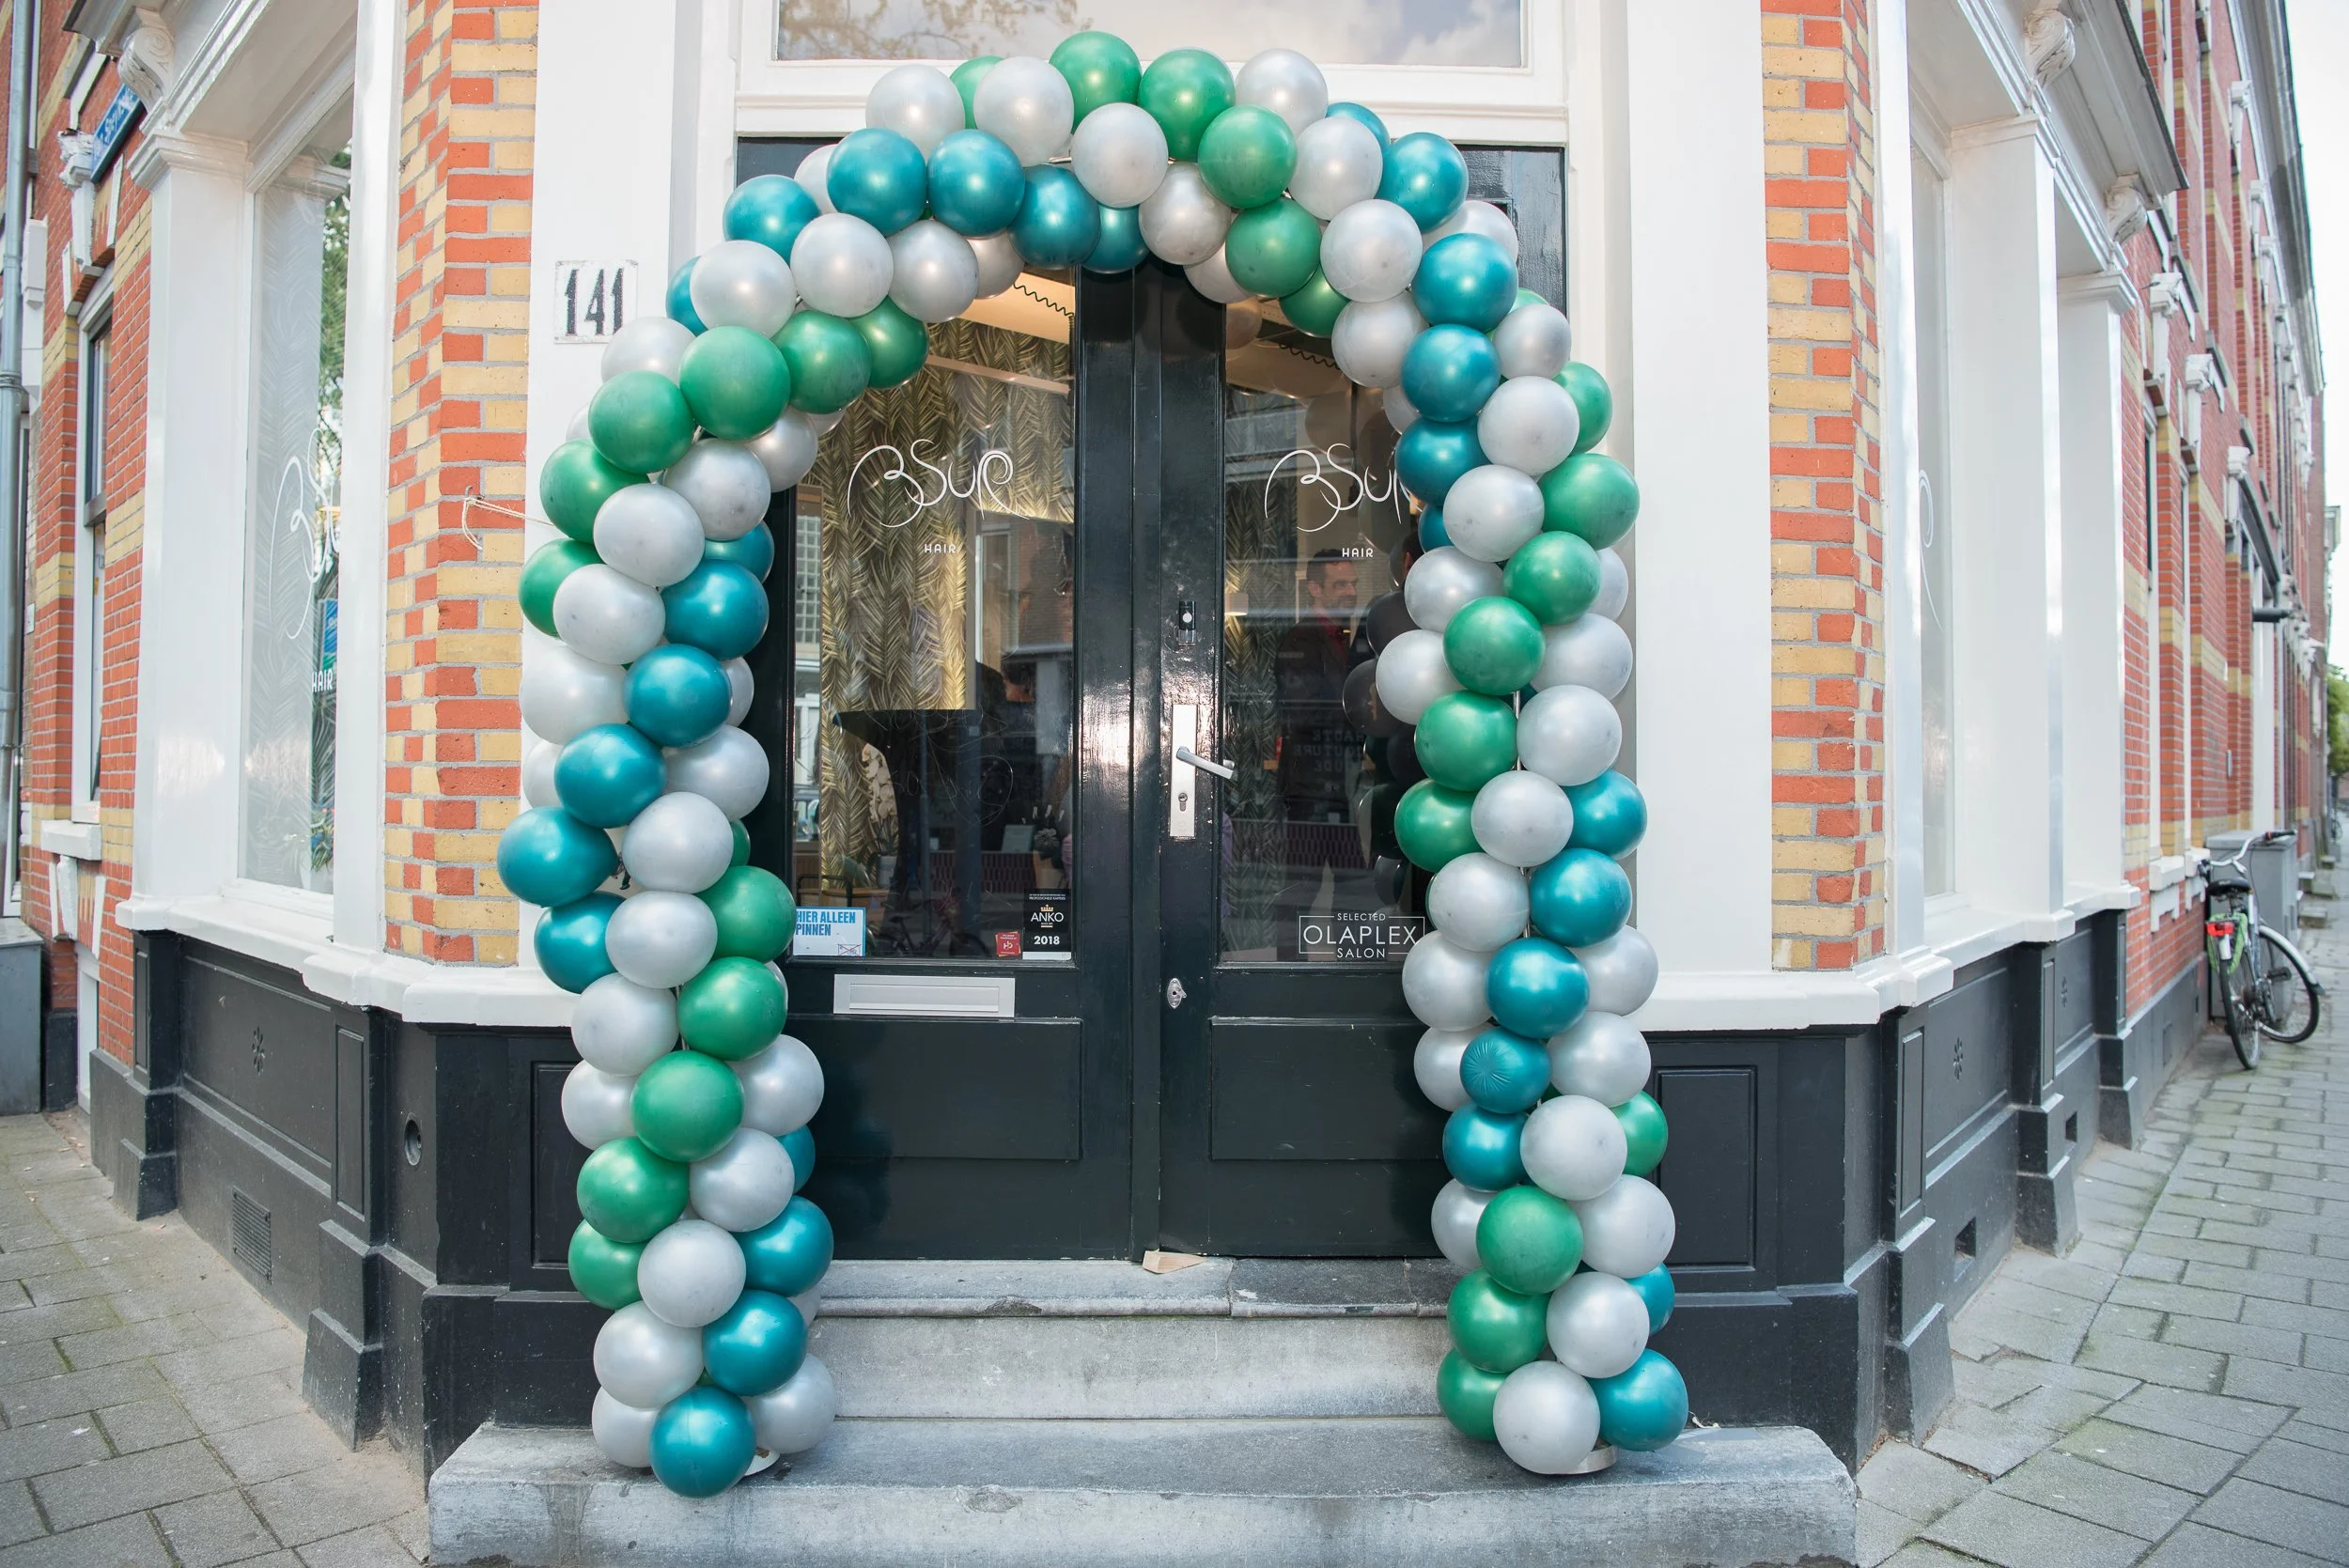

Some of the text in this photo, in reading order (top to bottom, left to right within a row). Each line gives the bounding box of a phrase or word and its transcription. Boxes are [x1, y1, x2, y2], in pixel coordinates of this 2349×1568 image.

[565, 268, 623, 335] 141
[924, 543, 957, 553] HAIR
[1342, 547, 1374, 558] HAIR
[312, 668, 334, 692] HAIR
[796, 911, 856, 924] HIER ALLEEN
[1030, 912, 1065, 923] ANKO
[1337, 912, 1386, 921] SELECTED
[796, 924, 832, 936] PINNEN
[1303, 924, 1417, 944] OLAPLEX
[1034, 936, 1061, 945] 2018
[1336, 947, 1385, 958] SALON
